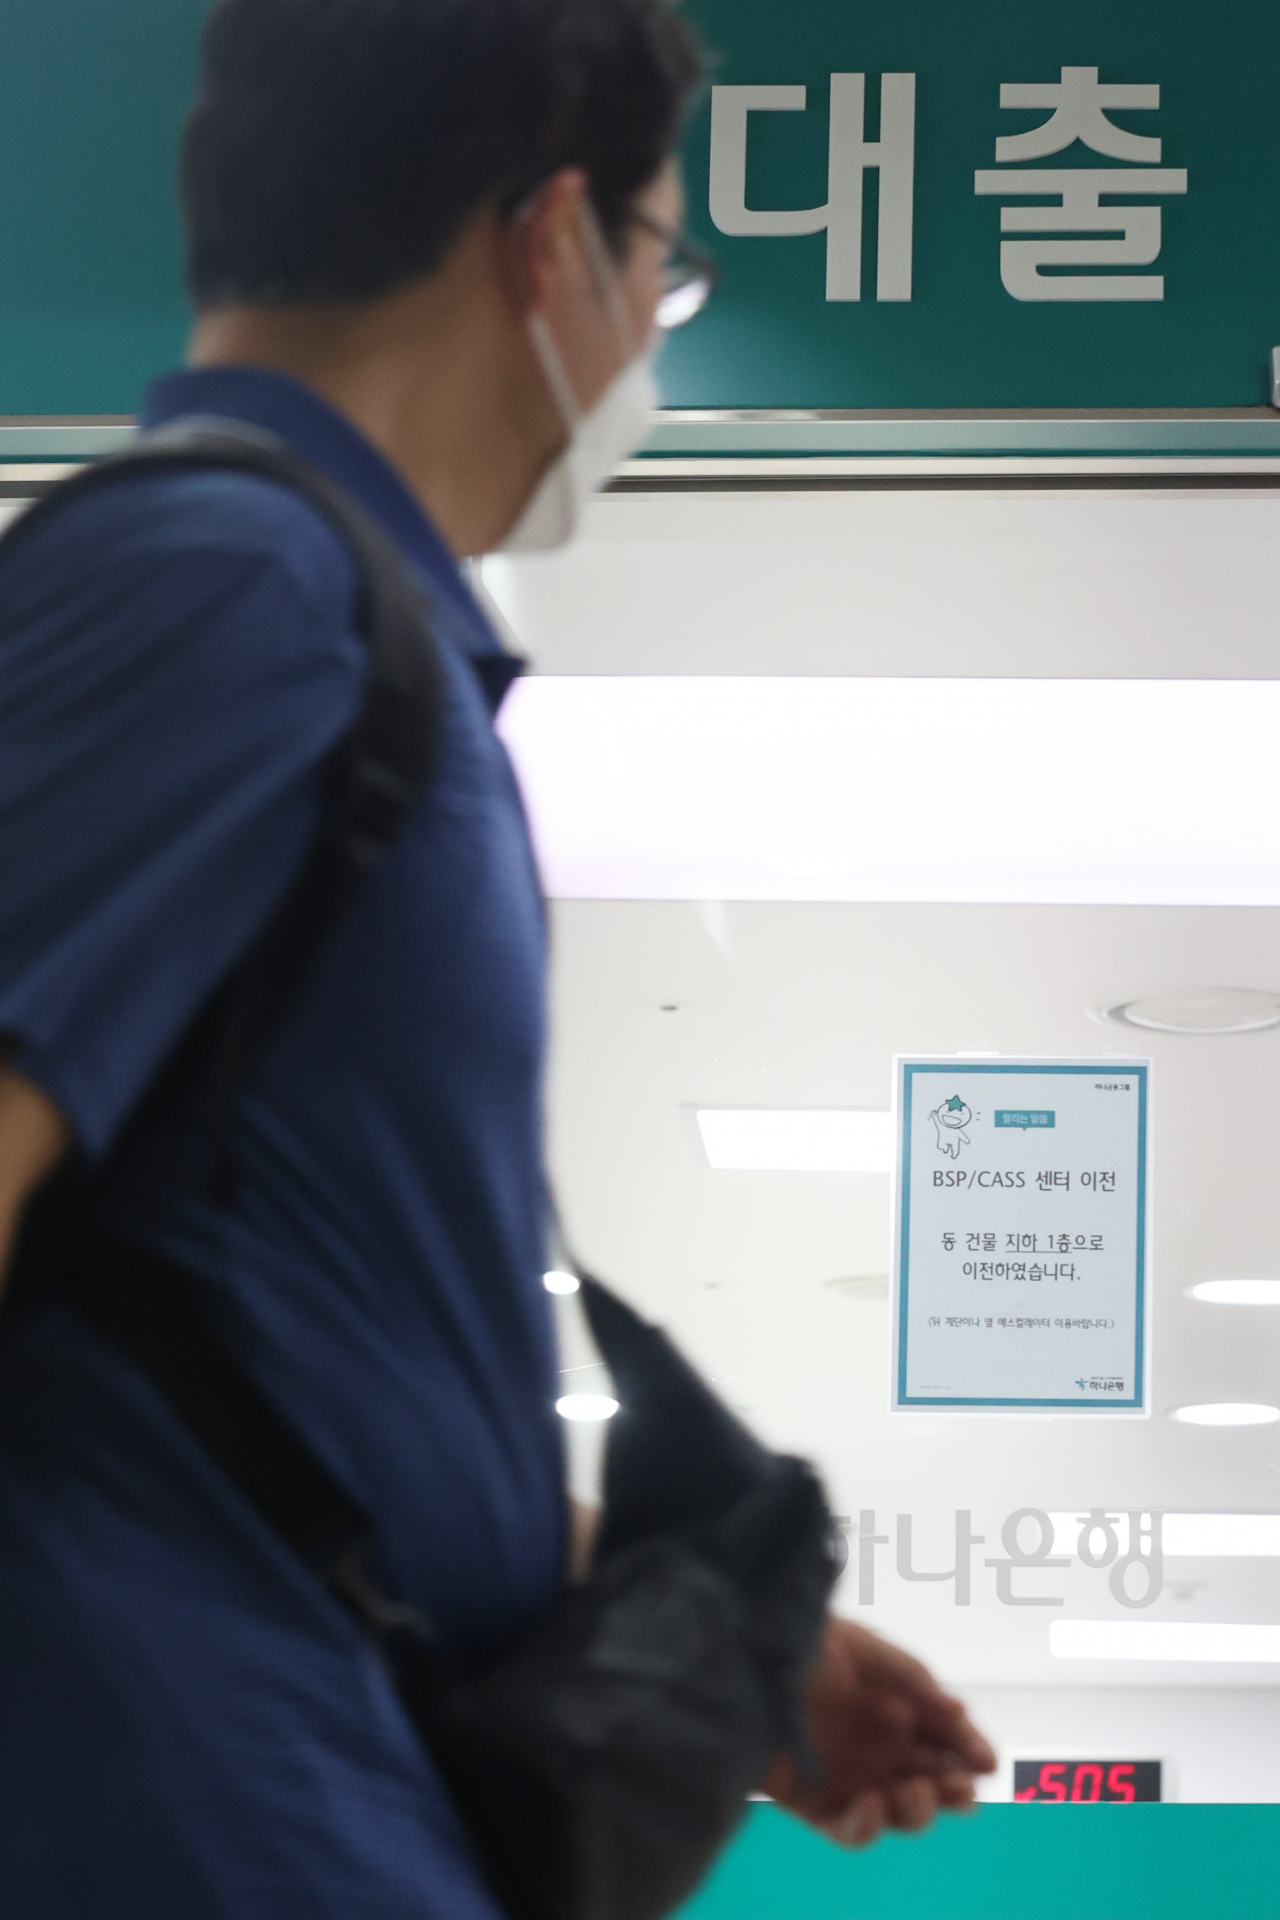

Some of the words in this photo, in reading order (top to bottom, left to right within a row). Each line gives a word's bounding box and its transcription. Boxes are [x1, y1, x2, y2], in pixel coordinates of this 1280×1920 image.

[709, 66, 1187, 302] 대출
[933, 1170, 1026, 1189] BSP/CASS
[1035, 1171, 1070, 1191] 센터
[1080, 1172, 1116, 1192] 이전
[941, 1232, 957, 1251] 동
[965, 1232, 998, 1252] 건물
[1005, 1233, 1038, 1252] 지하
[1047, 1233, 1105, 1253] 1층으로
[962, 1262, 1082, 1281] 이전하였습니다.
[997, 1317, 1051, 1329] 에스컬레이터
[1090, 1381, 1125, 1391] 하나은행
